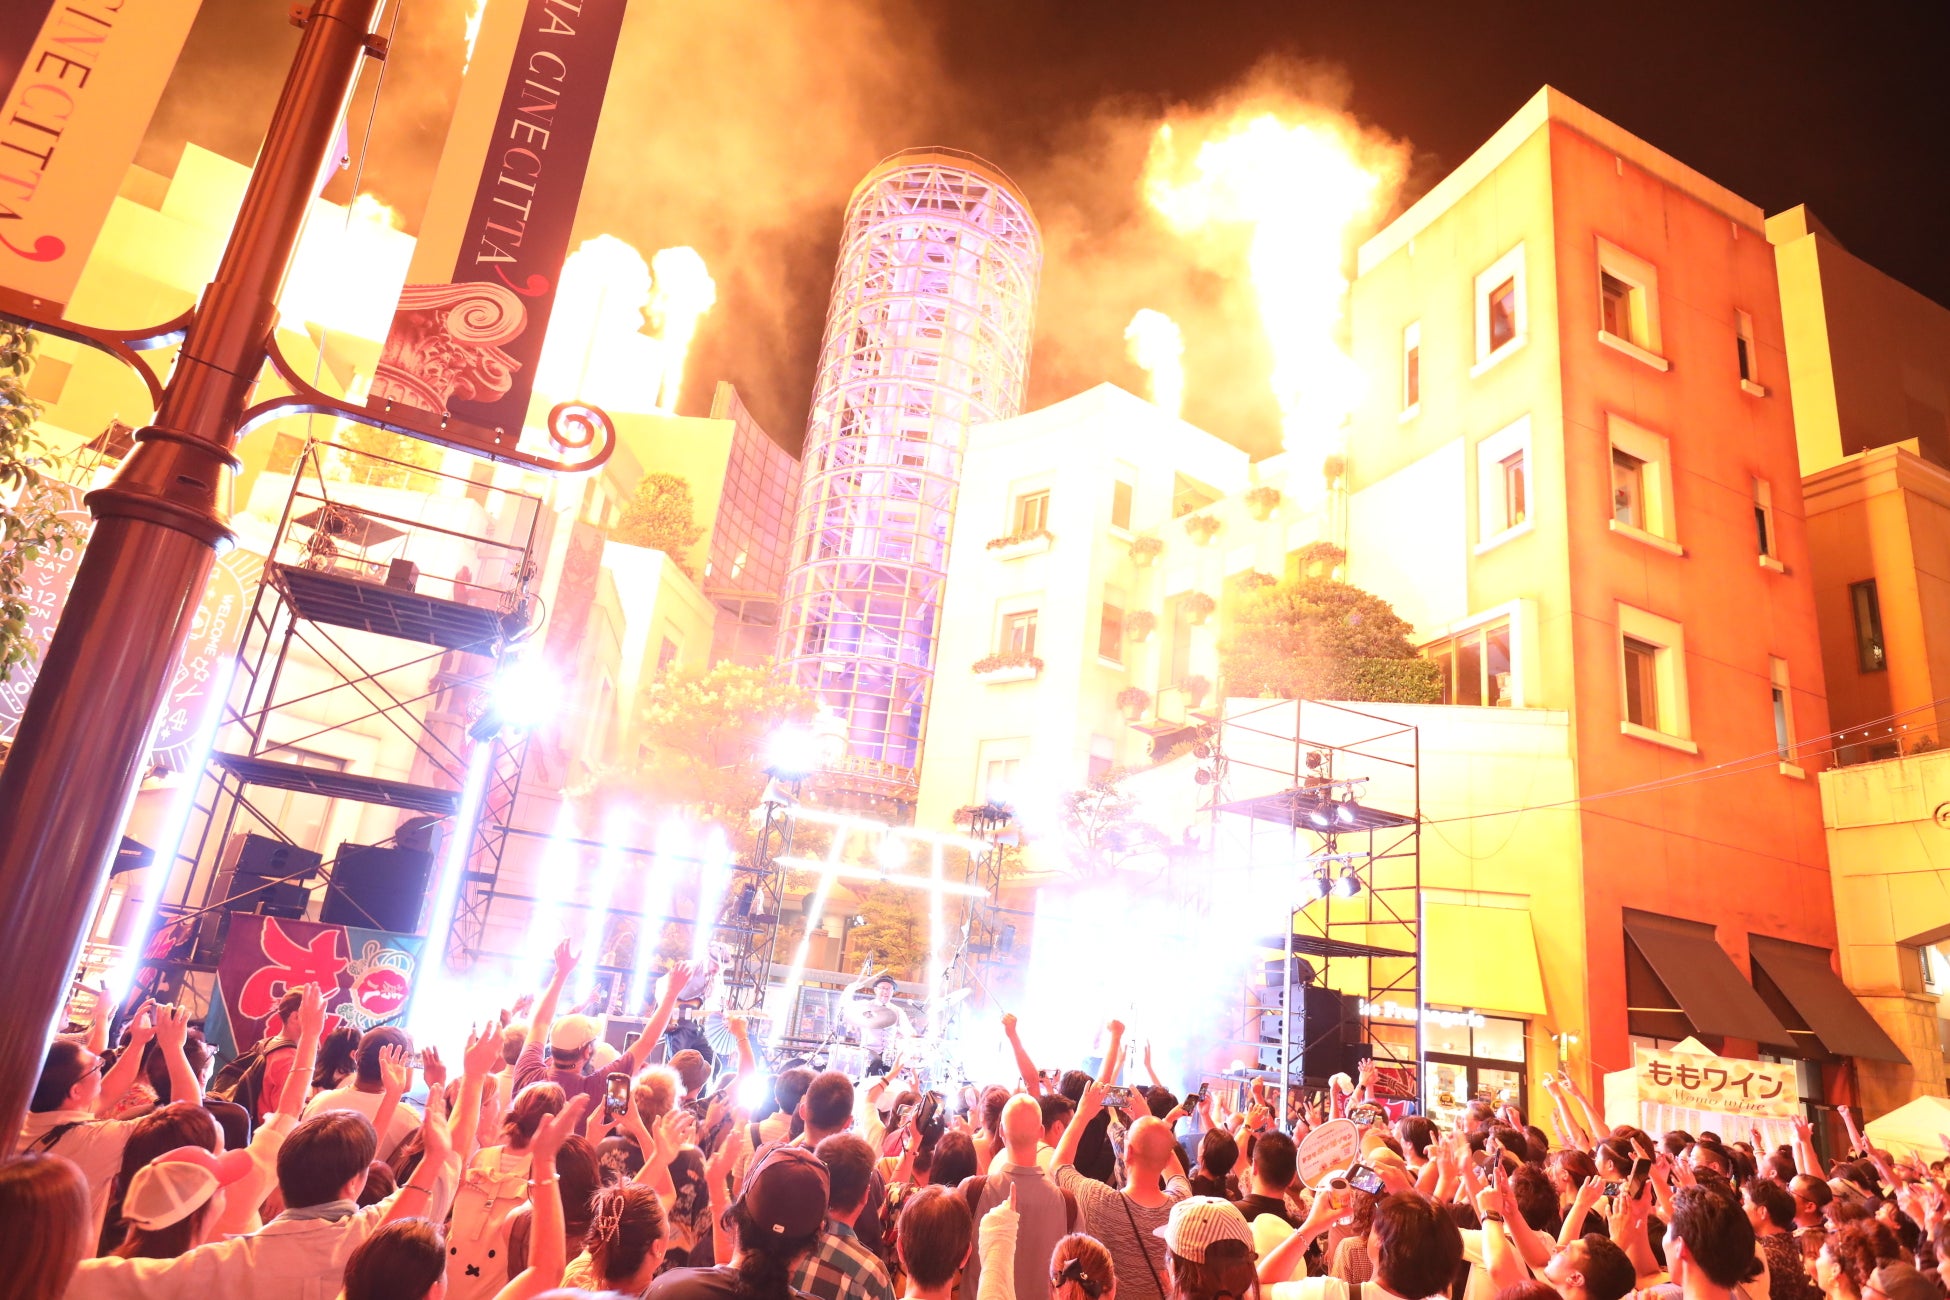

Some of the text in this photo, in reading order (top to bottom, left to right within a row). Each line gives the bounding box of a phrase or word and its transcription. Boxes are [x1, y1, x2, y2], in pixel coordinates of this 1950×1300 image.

[34, 557, 67, 574] SAT
[204, 594, 236, 657] WELCOME
[1648, 1060, 1783, 1099] ももワイン
[1671, 1088, 1766, 1112] Momo wine
